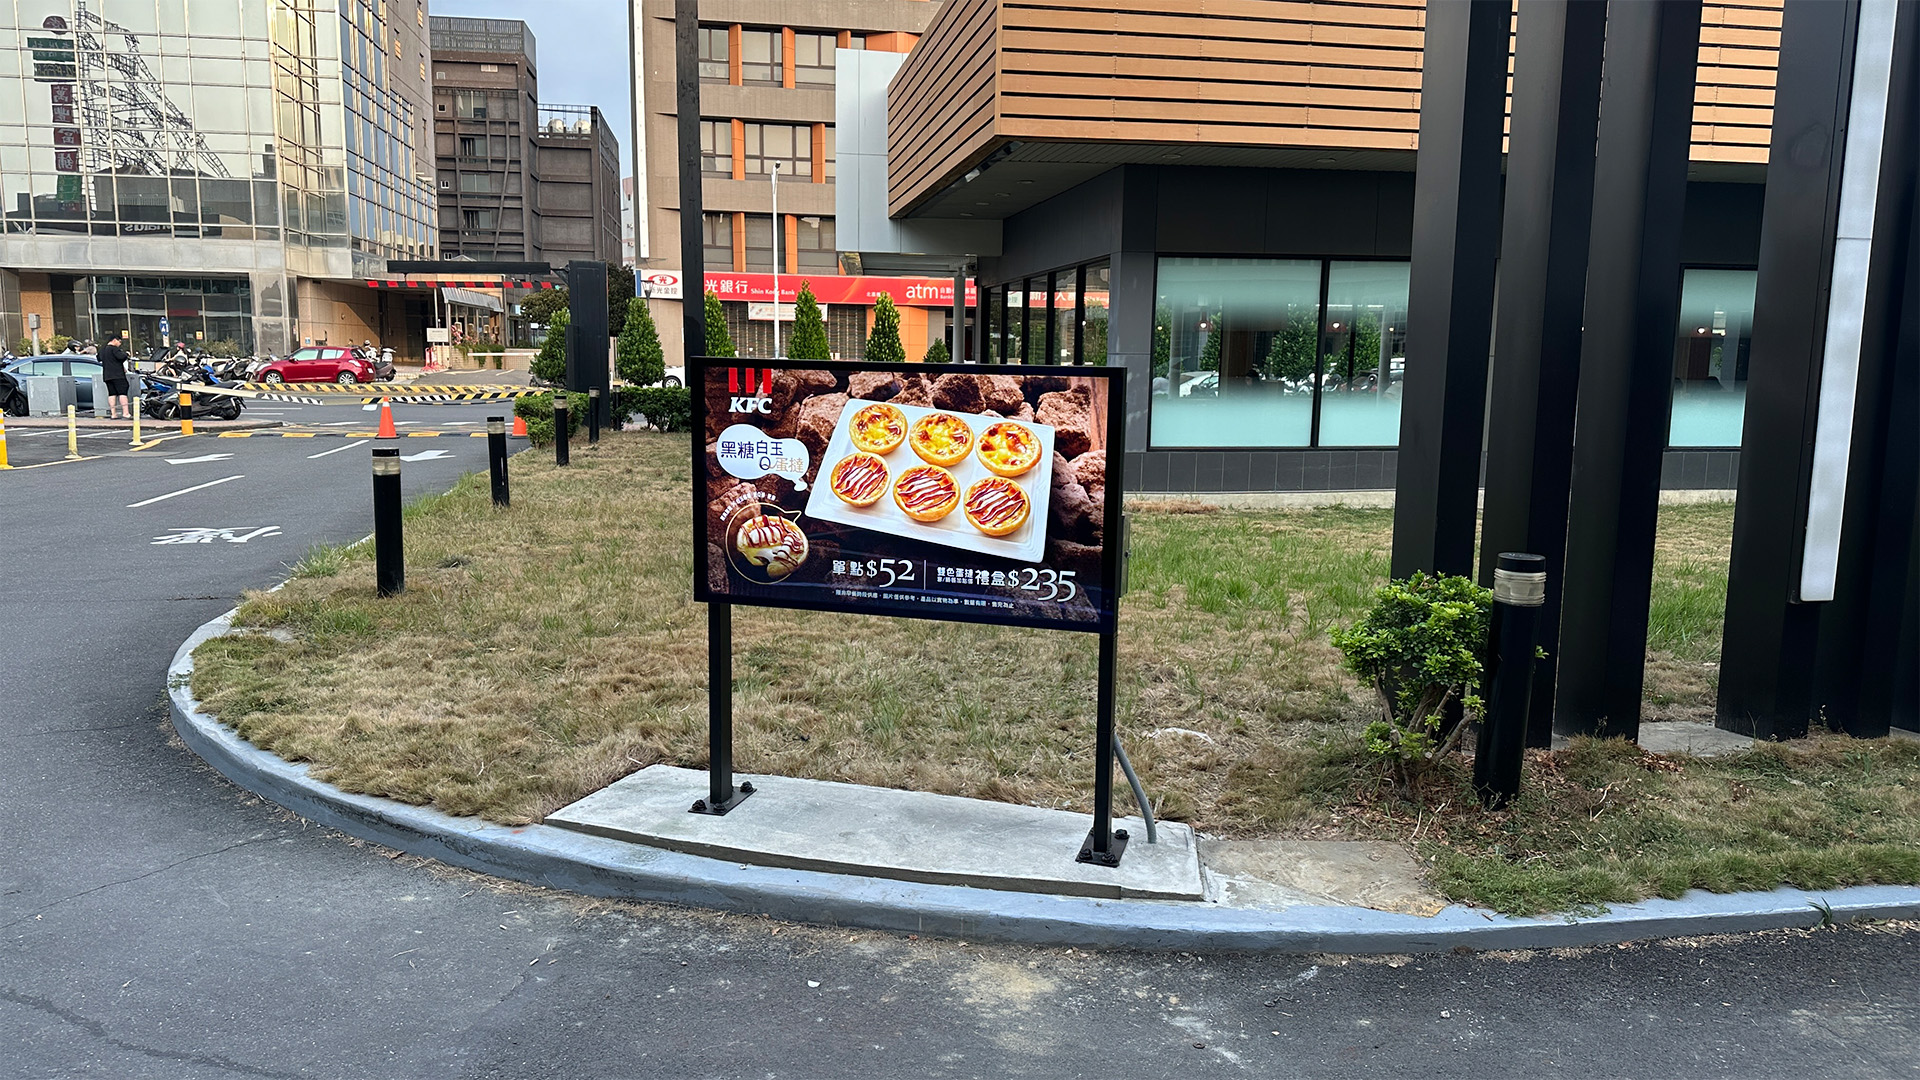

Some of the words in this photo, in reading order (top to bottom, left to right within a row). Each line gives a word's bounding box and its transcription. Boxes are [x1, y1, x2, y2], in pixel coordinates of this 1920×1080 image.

[906, 283, 939, 299] atm
[728, 396, 773, 414] KFC
[720, 440, 784, 459] 黑糖白玉
[832, 559, 864, 576] 單點
[866, 558, 916, 588] $52
[975, 569, 1006, 587] 禮盒
[1007, 567, 1077, 603] $235
